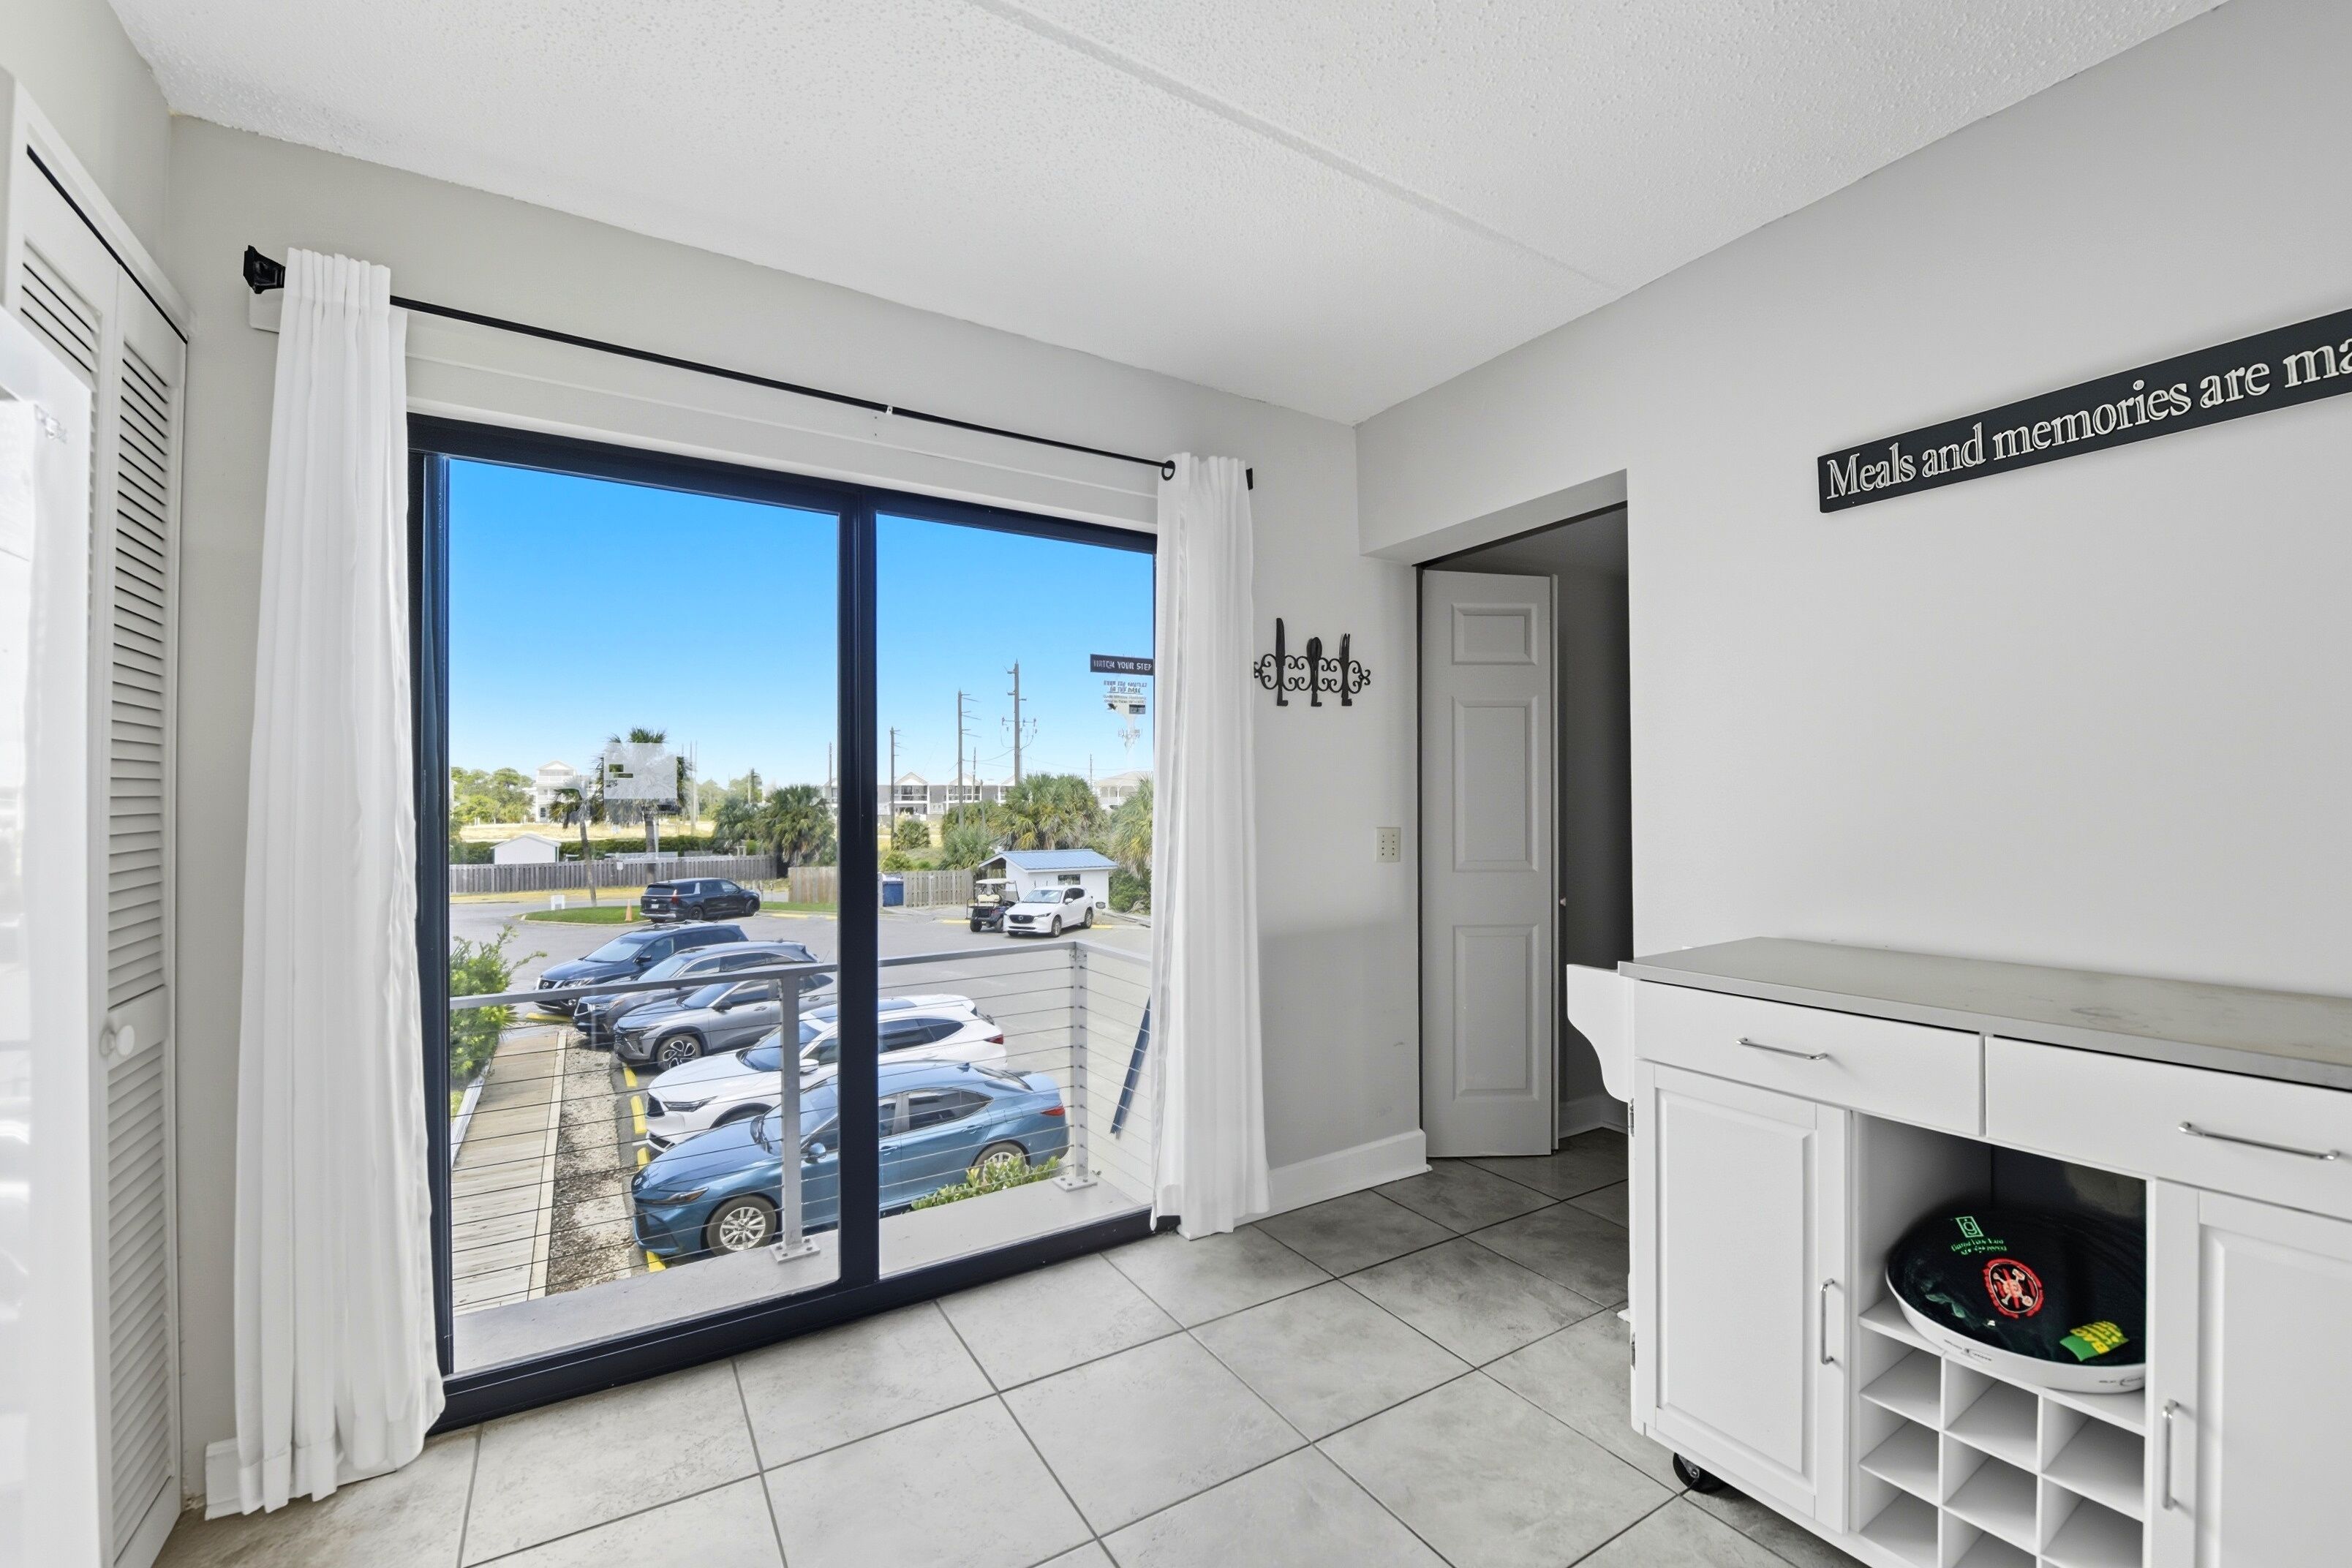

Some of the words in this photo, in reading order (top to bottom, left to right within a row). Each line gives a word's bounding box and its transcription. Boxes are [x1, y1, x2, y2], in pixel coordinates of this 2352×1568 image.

[1826, 442, 1917, 500] Meals
[1921, 421, 1987, 478] and
[1991, 380, 2192, 461] memories
[2199, 363, 2270, 409] are
[1117, 661, 1134, 670] YOUR
[1137, 663, 1153, 671] STEP
